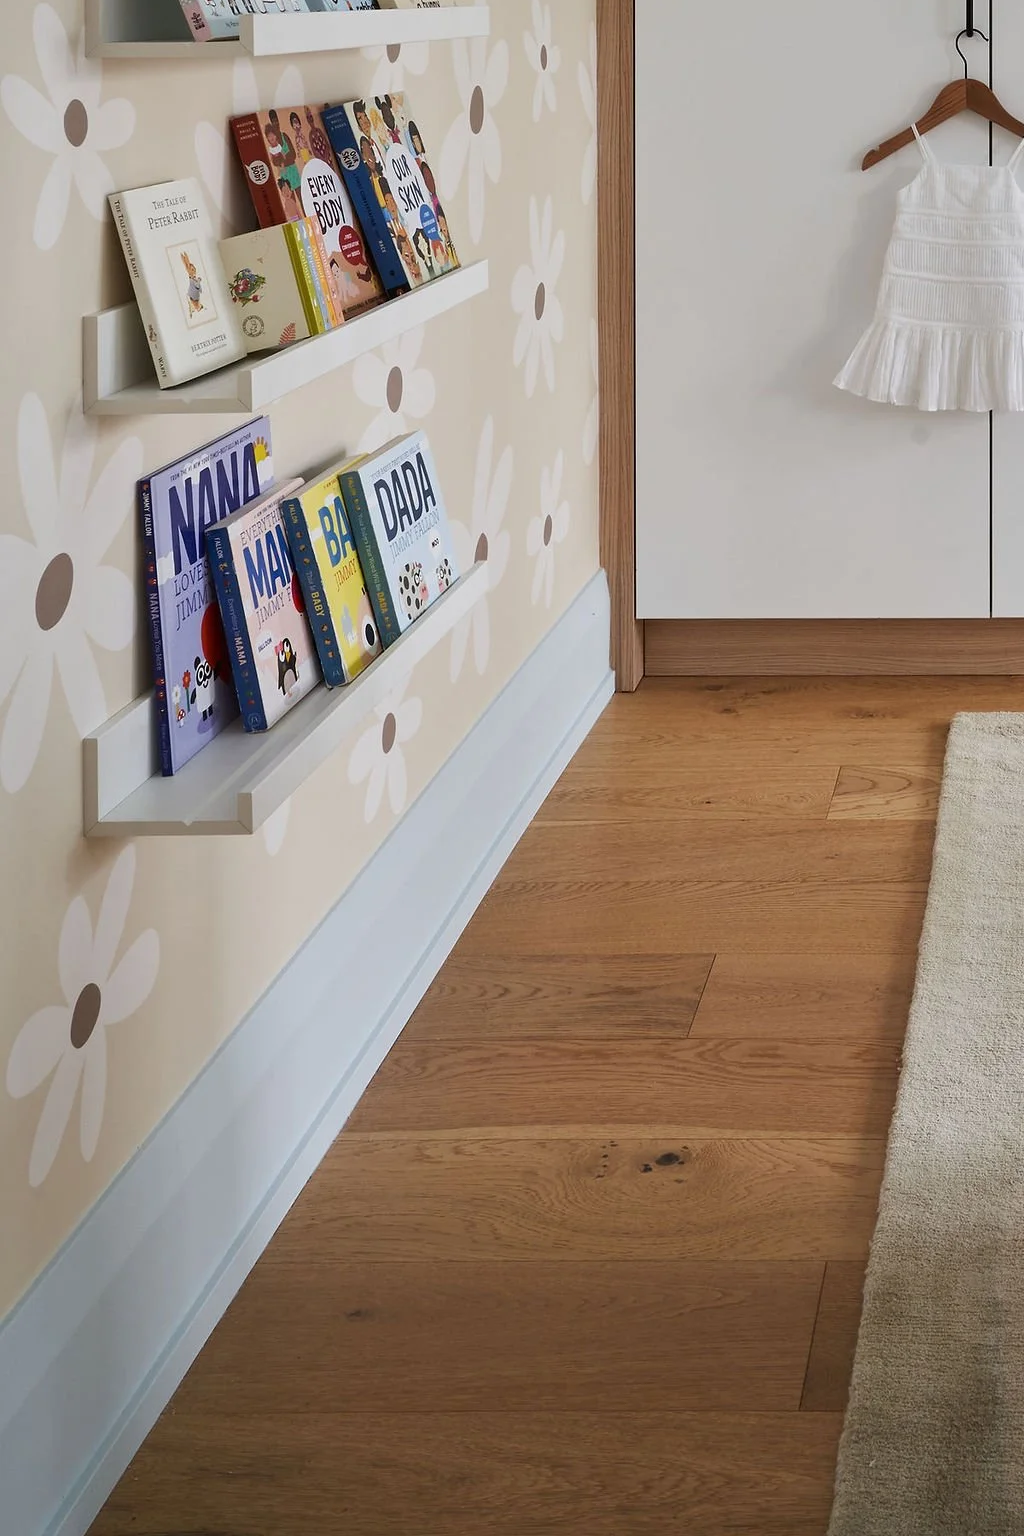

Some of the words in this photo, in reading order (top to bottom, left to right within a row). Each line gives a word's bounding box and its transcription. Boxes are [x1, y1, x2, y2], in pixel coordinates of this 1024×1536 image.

[341, 150, 354, 169] SKIN
[350, 150, 359, 164] OUR
[391, 153, 412, 181] OUR
[250, 165, 263, 182] BODY
[307, 174, 337, 198] EVERY
[152, 199, 166, 211] THE
[166, 196, 179, 208] TALE
[178, 194, 187, 204] OF
[397, 175, 425, 213] SKIN
[148, 214, 173, 231] PETER
[171, 208, 201, 226] RABBIT
[313, 196, 346, 235] BODY
[118, 213, 127, 230] TALE
[125, 238, 134, 257] PETER
[130, 256, 140, 279] RABBIT
[142, 492, 150, 512] JIMMY
[168, 442, 261, 576] NANA
[373, 451, 436, 542] DADA
[143, 511, 152, 537] FALLON
[287, 503, 299, 524] FALLON
[214, 537, 224, 559] FALLON
[389, 529, 414, 564] JIMMY
[412, 507, 440, 542] FALLON
[431, 537, 440, 548] MOO
[334, 558, 357, 592] JIMMY
[149, 592, 158, 619] NANA
[255, 590, 286, 630] JIMMY
[310, 591, 325, 617] BABY
[376, 591, 389, 614] DADA
[235, 636, 248, 666] MAMA
